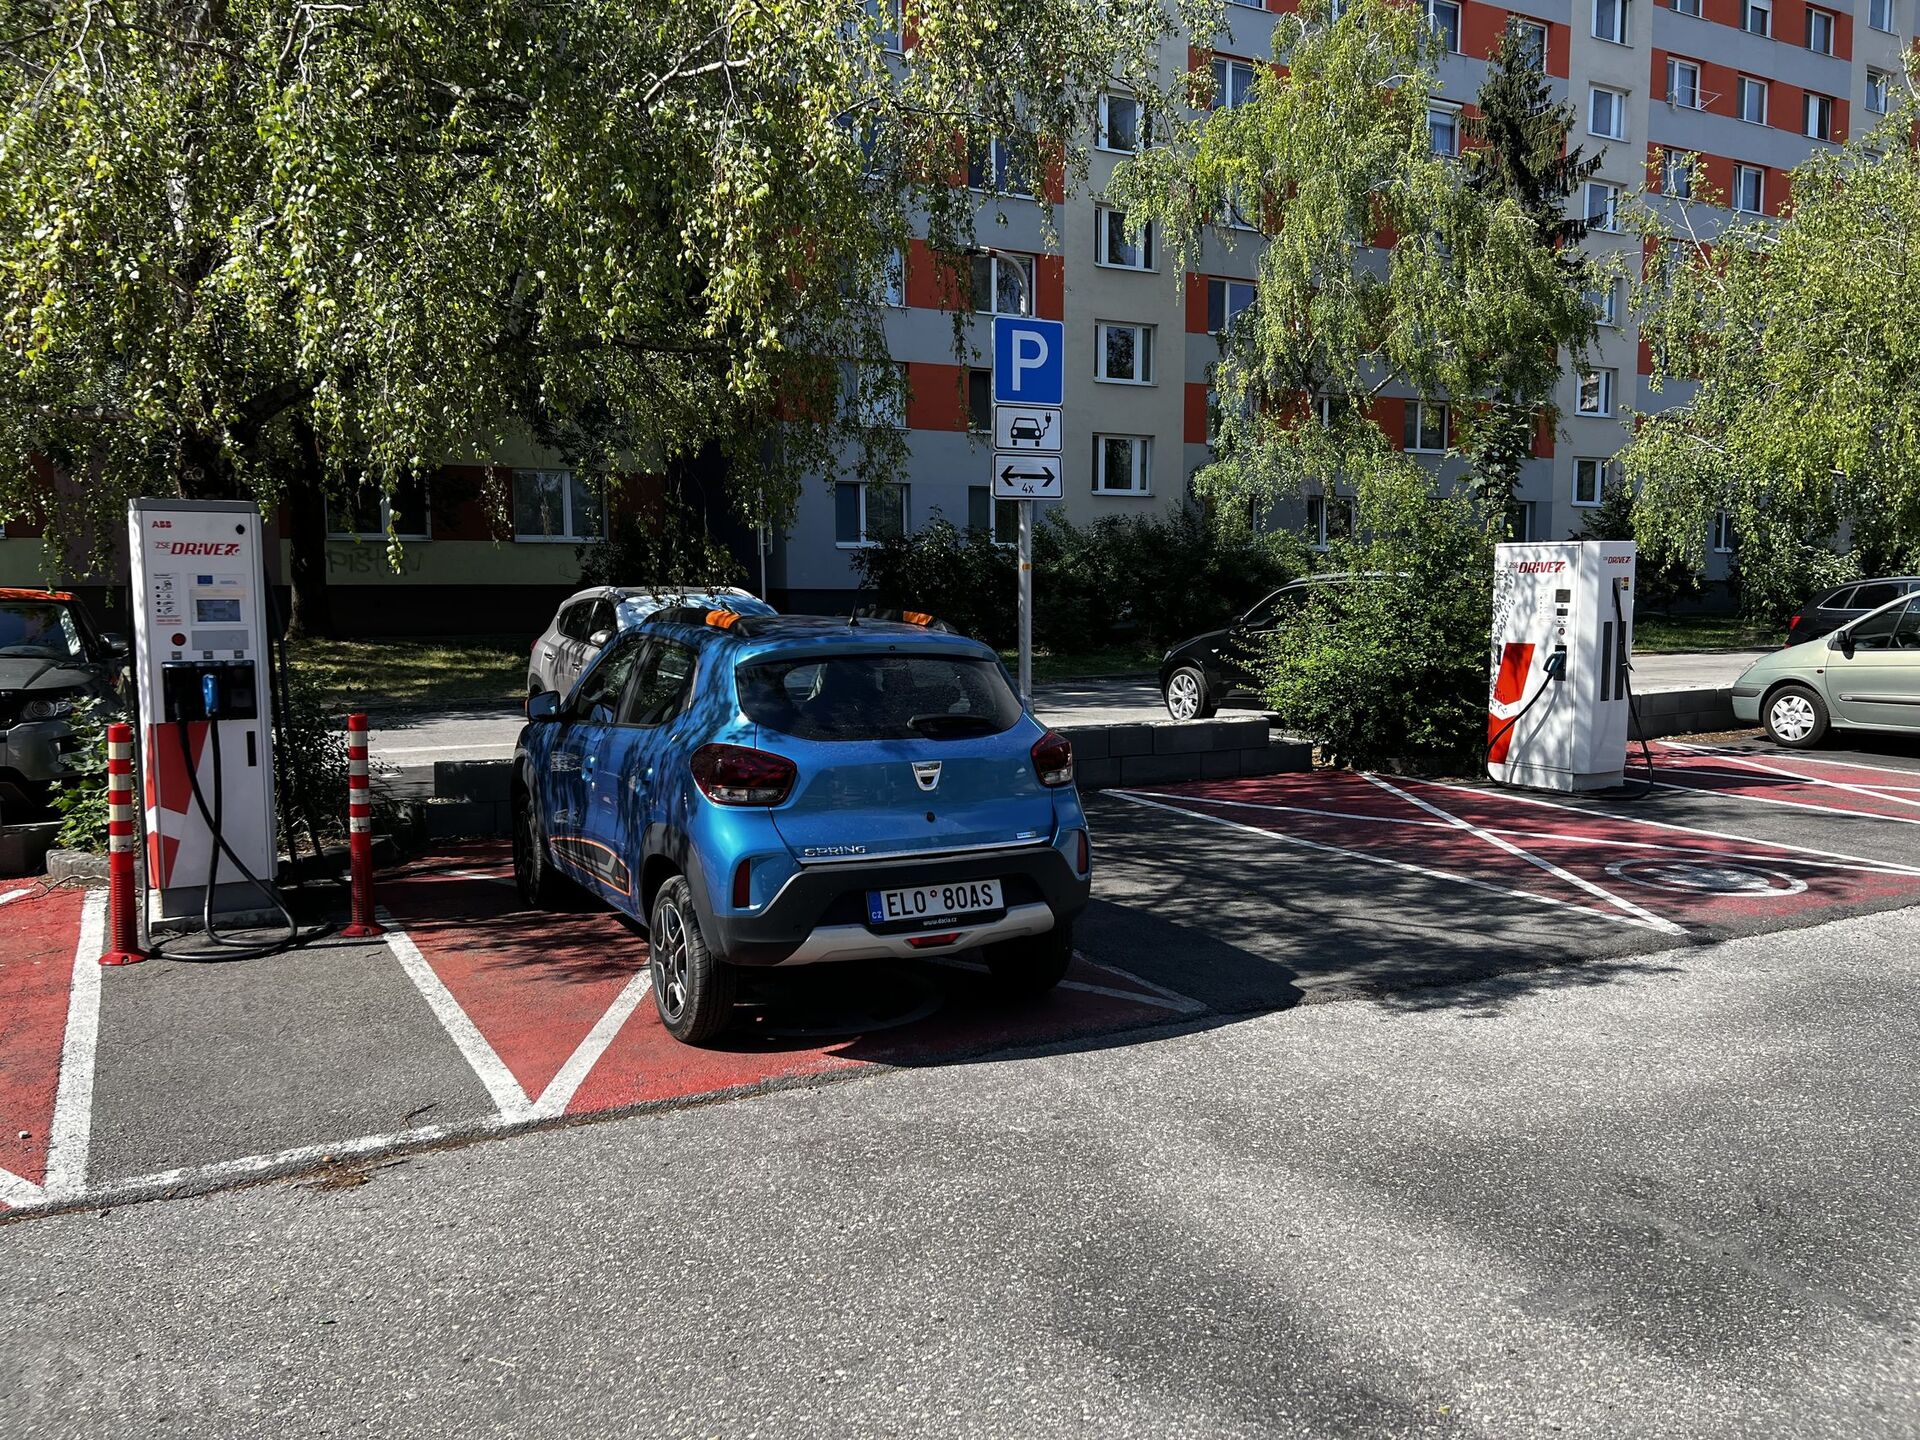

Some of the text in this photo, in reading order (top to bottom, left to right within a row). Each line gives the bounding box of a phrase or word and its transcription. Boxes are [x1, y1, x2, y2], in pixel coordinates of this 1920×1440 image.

[1012, 329, 1049, 391] P
[1021, 482, 1034, 494] 4x
[152, 520, 172, 528] ABB
[804, 845, 866, 857] SPRING
[871, 911, 883, 919] CZ
